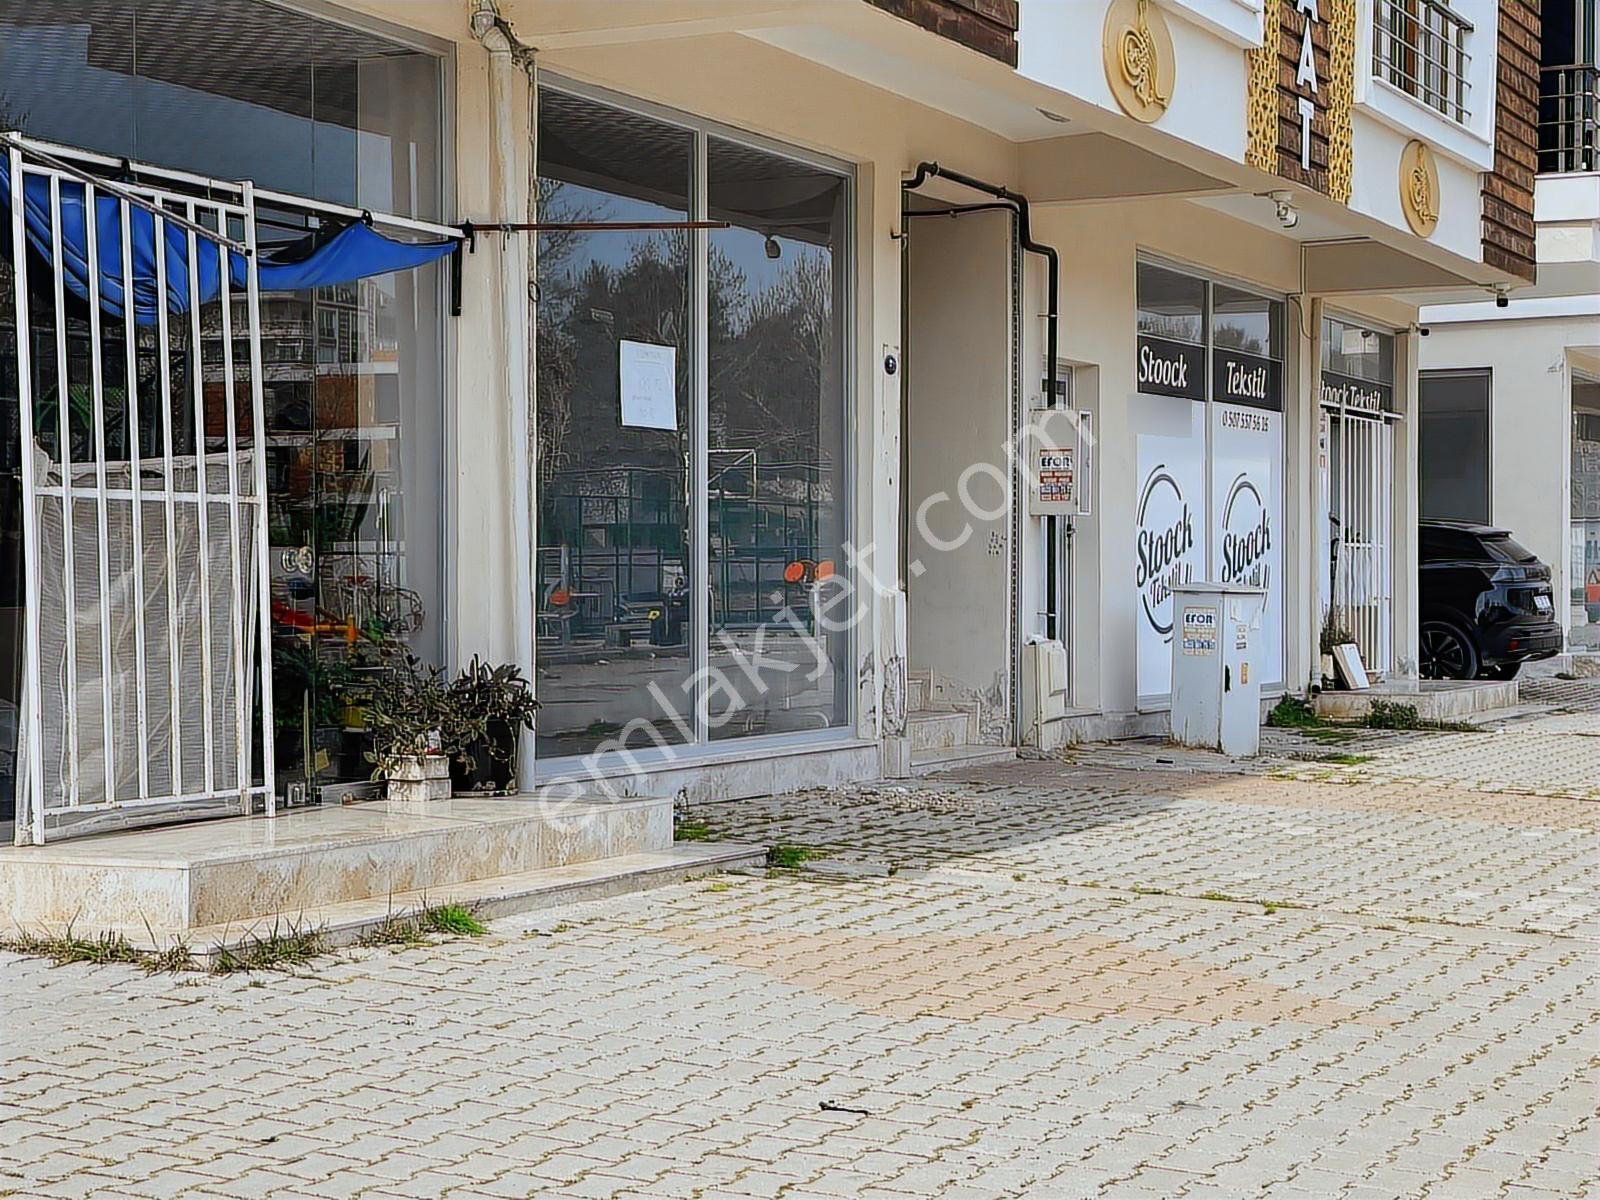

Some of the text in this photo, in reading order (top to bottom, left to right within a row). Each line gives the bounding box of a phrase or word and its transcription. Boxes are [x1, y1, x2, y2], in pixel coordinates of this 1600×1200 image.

[1139, 346, 1267, 399] Stoock Tekstil
[1350, 387, 1380, 411] Tekstil
[1137, 504, 1192, 587] Stoock
[1222, 509, 1270, 583] Stoock
